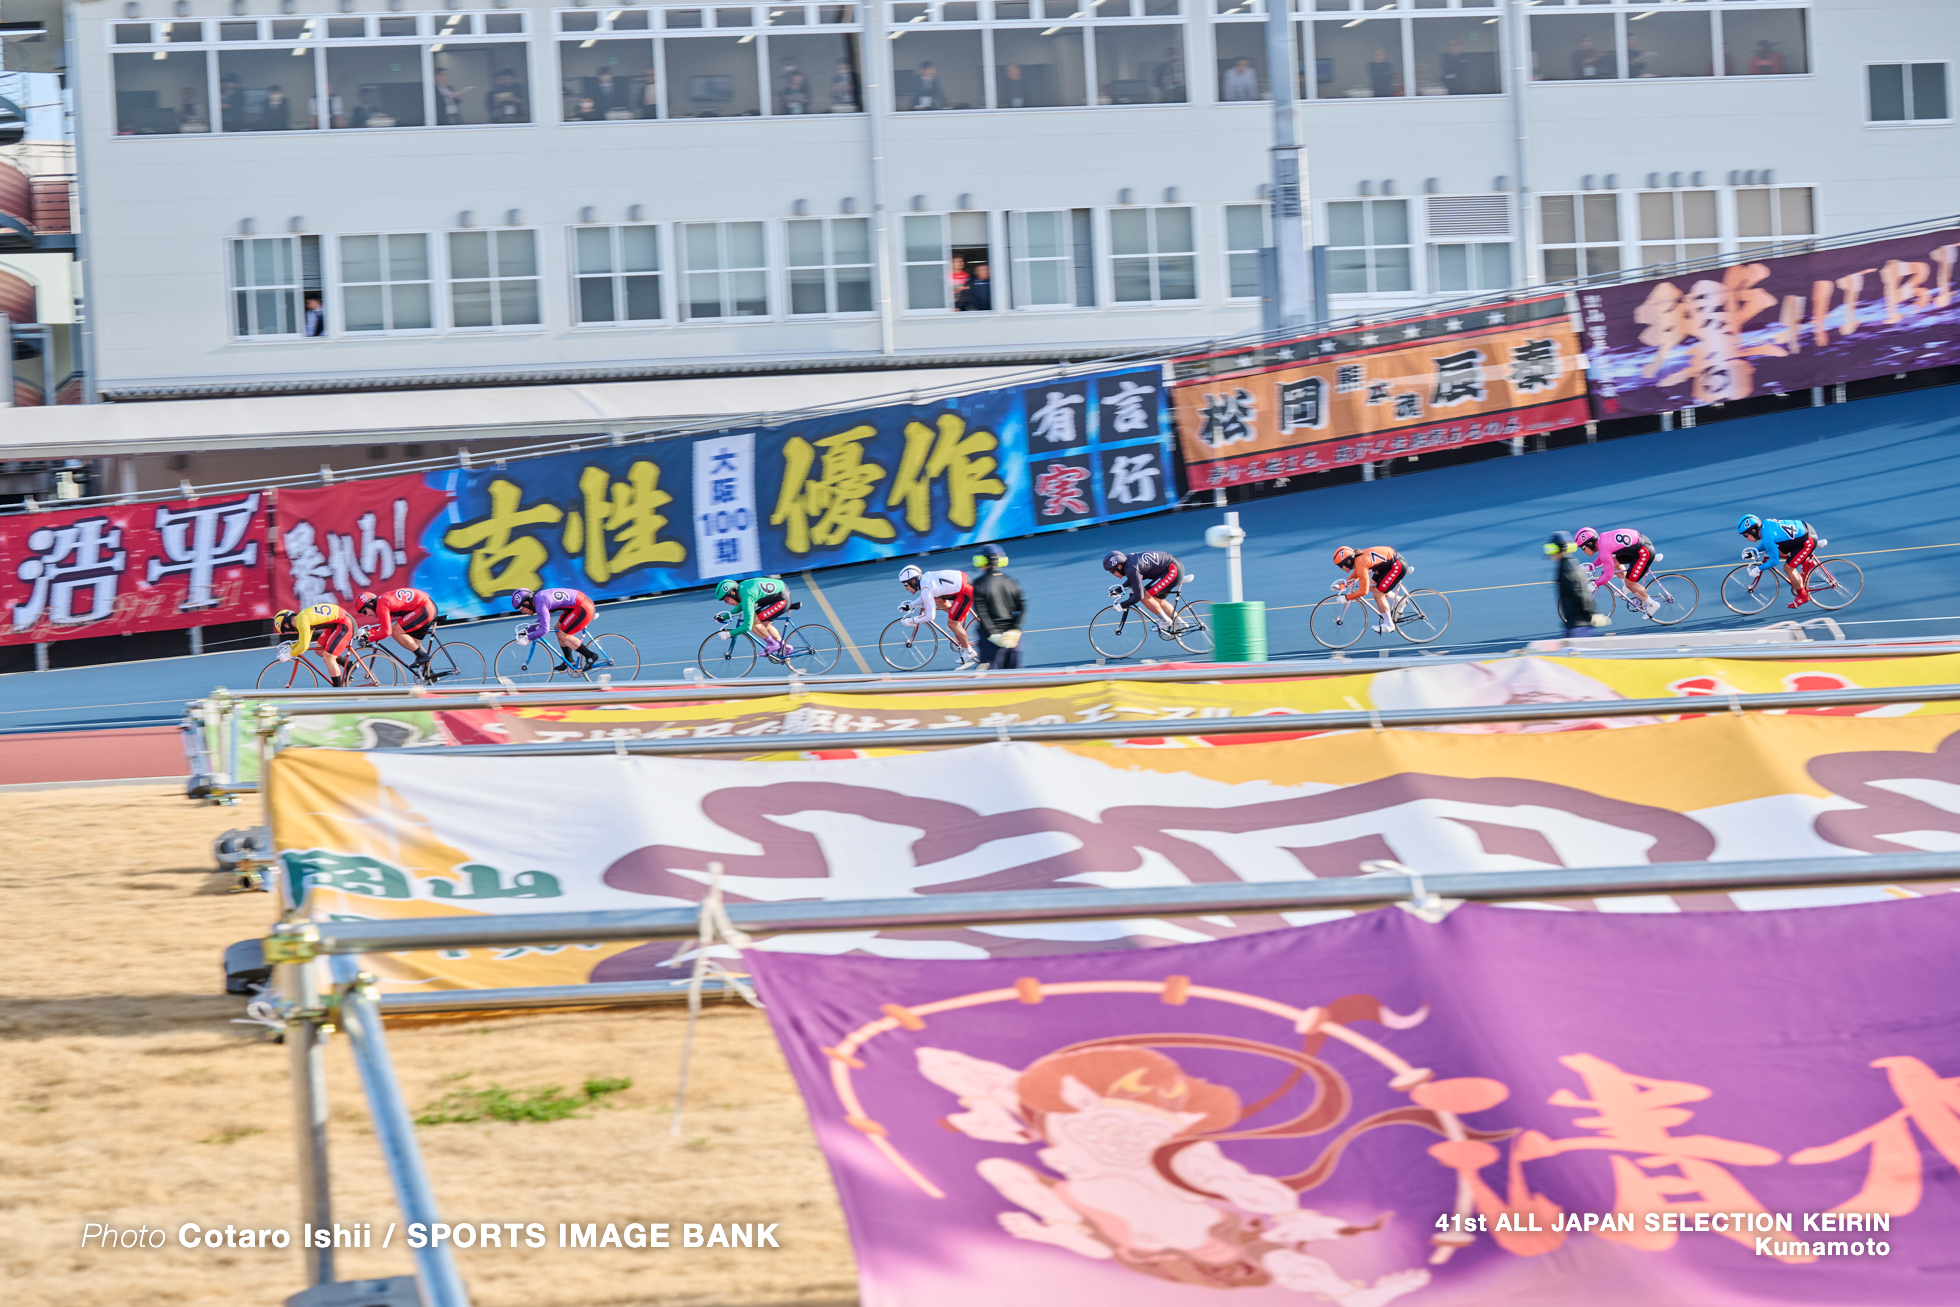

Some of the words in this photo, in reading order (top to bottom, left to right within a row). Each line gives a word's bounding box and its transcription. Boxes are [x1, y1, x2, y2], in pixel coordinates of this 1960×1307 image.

[770, 414, 1006, 553] 優作
[444, 460, 687, 599] 古性
[1781, 523, 1798, 540] 4
[1615, 533, 1632, 547] 8
[1142, 552, 1160, 566] 2
[1370, 551, 1387, 563] 7
[759, 582, 777, 594] 6
[938, 577, 955, 586] 1
[396, 589, 414, 603] 3
[552, 591, 570, 602] 9
[313, 604, 332, 617] 5
